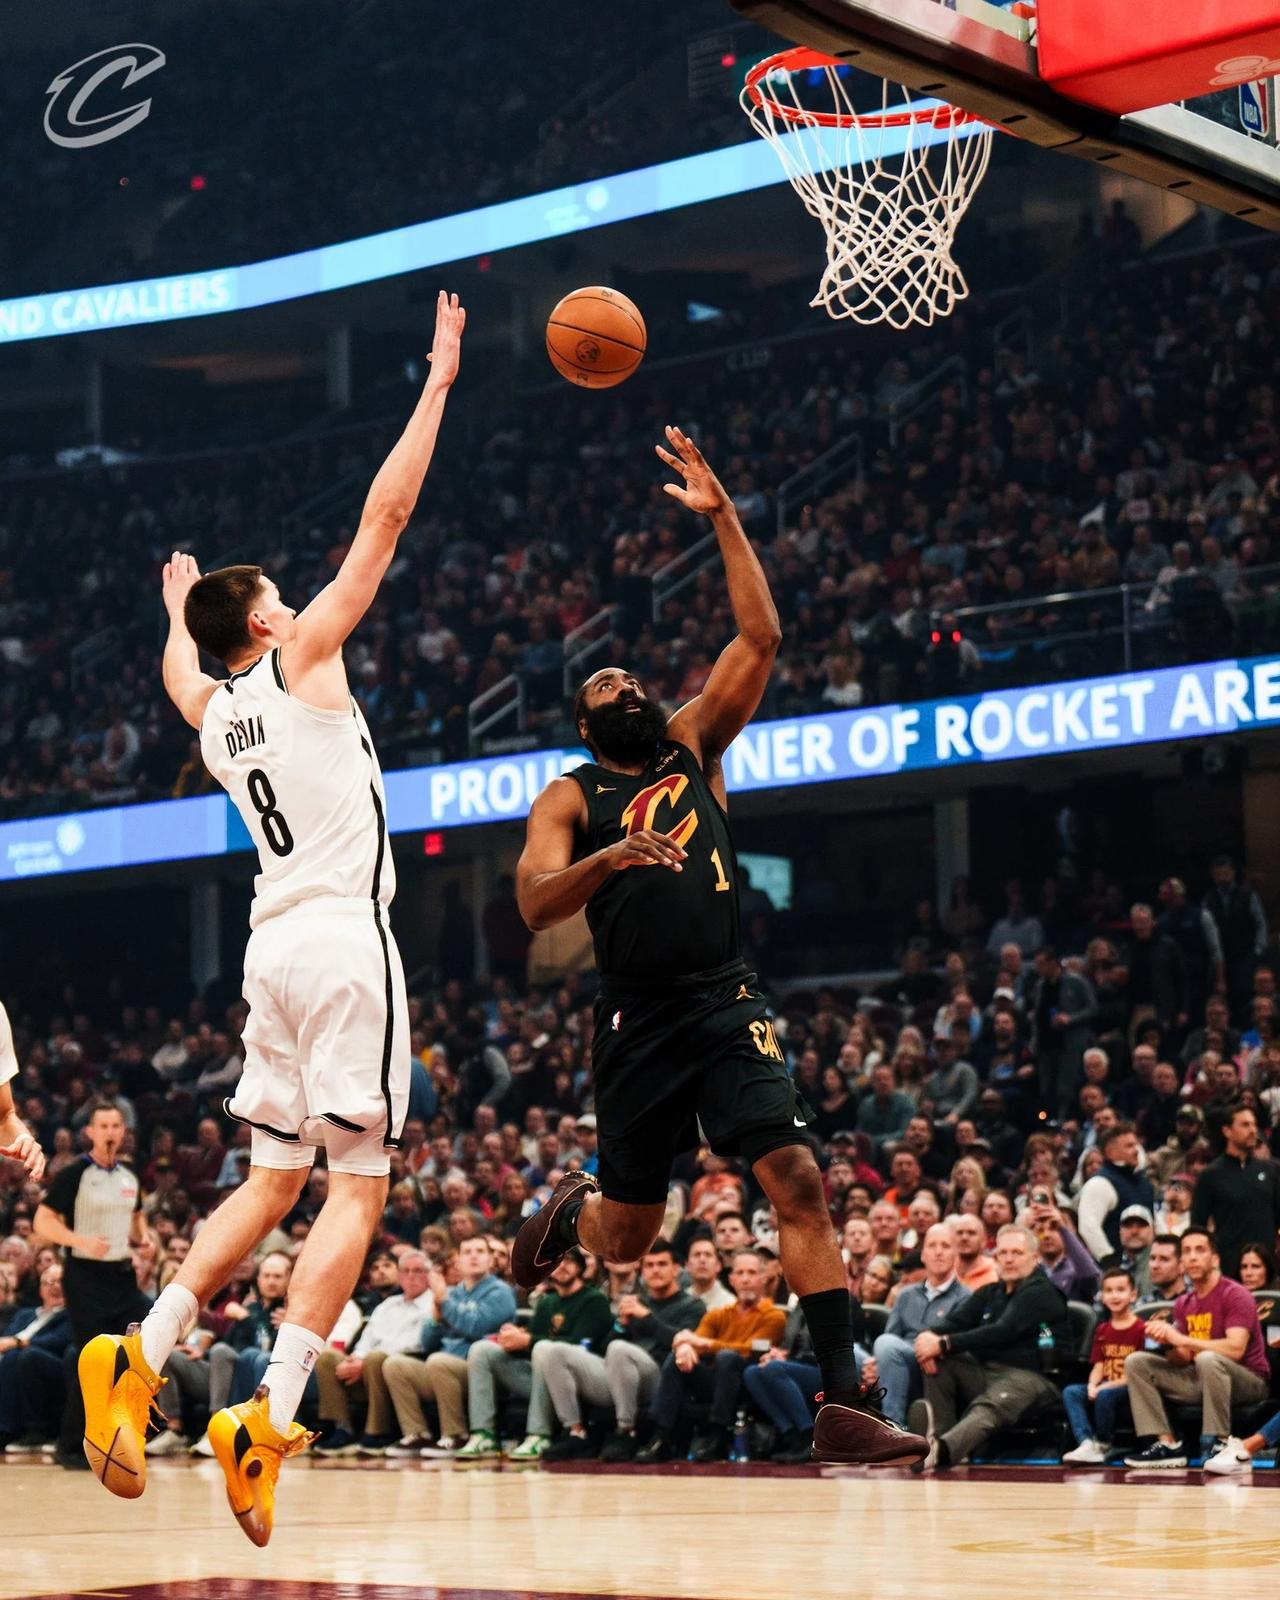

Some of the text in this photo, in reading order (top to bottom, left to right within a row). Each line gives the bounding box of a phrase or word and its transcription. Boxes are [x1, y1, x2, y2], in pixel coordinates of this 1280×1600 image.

[52, 273, 228, 329] CAVALIERS
[848, 708, 920, 769] OF
[934, 678, 1155, 761] ROCKET
[1169, 661, 1280, 731] ARE
[247, 768, 295, 857] 8
[710, 847, 730, 892] 1
[748, 1020, 785, 1064] CA
